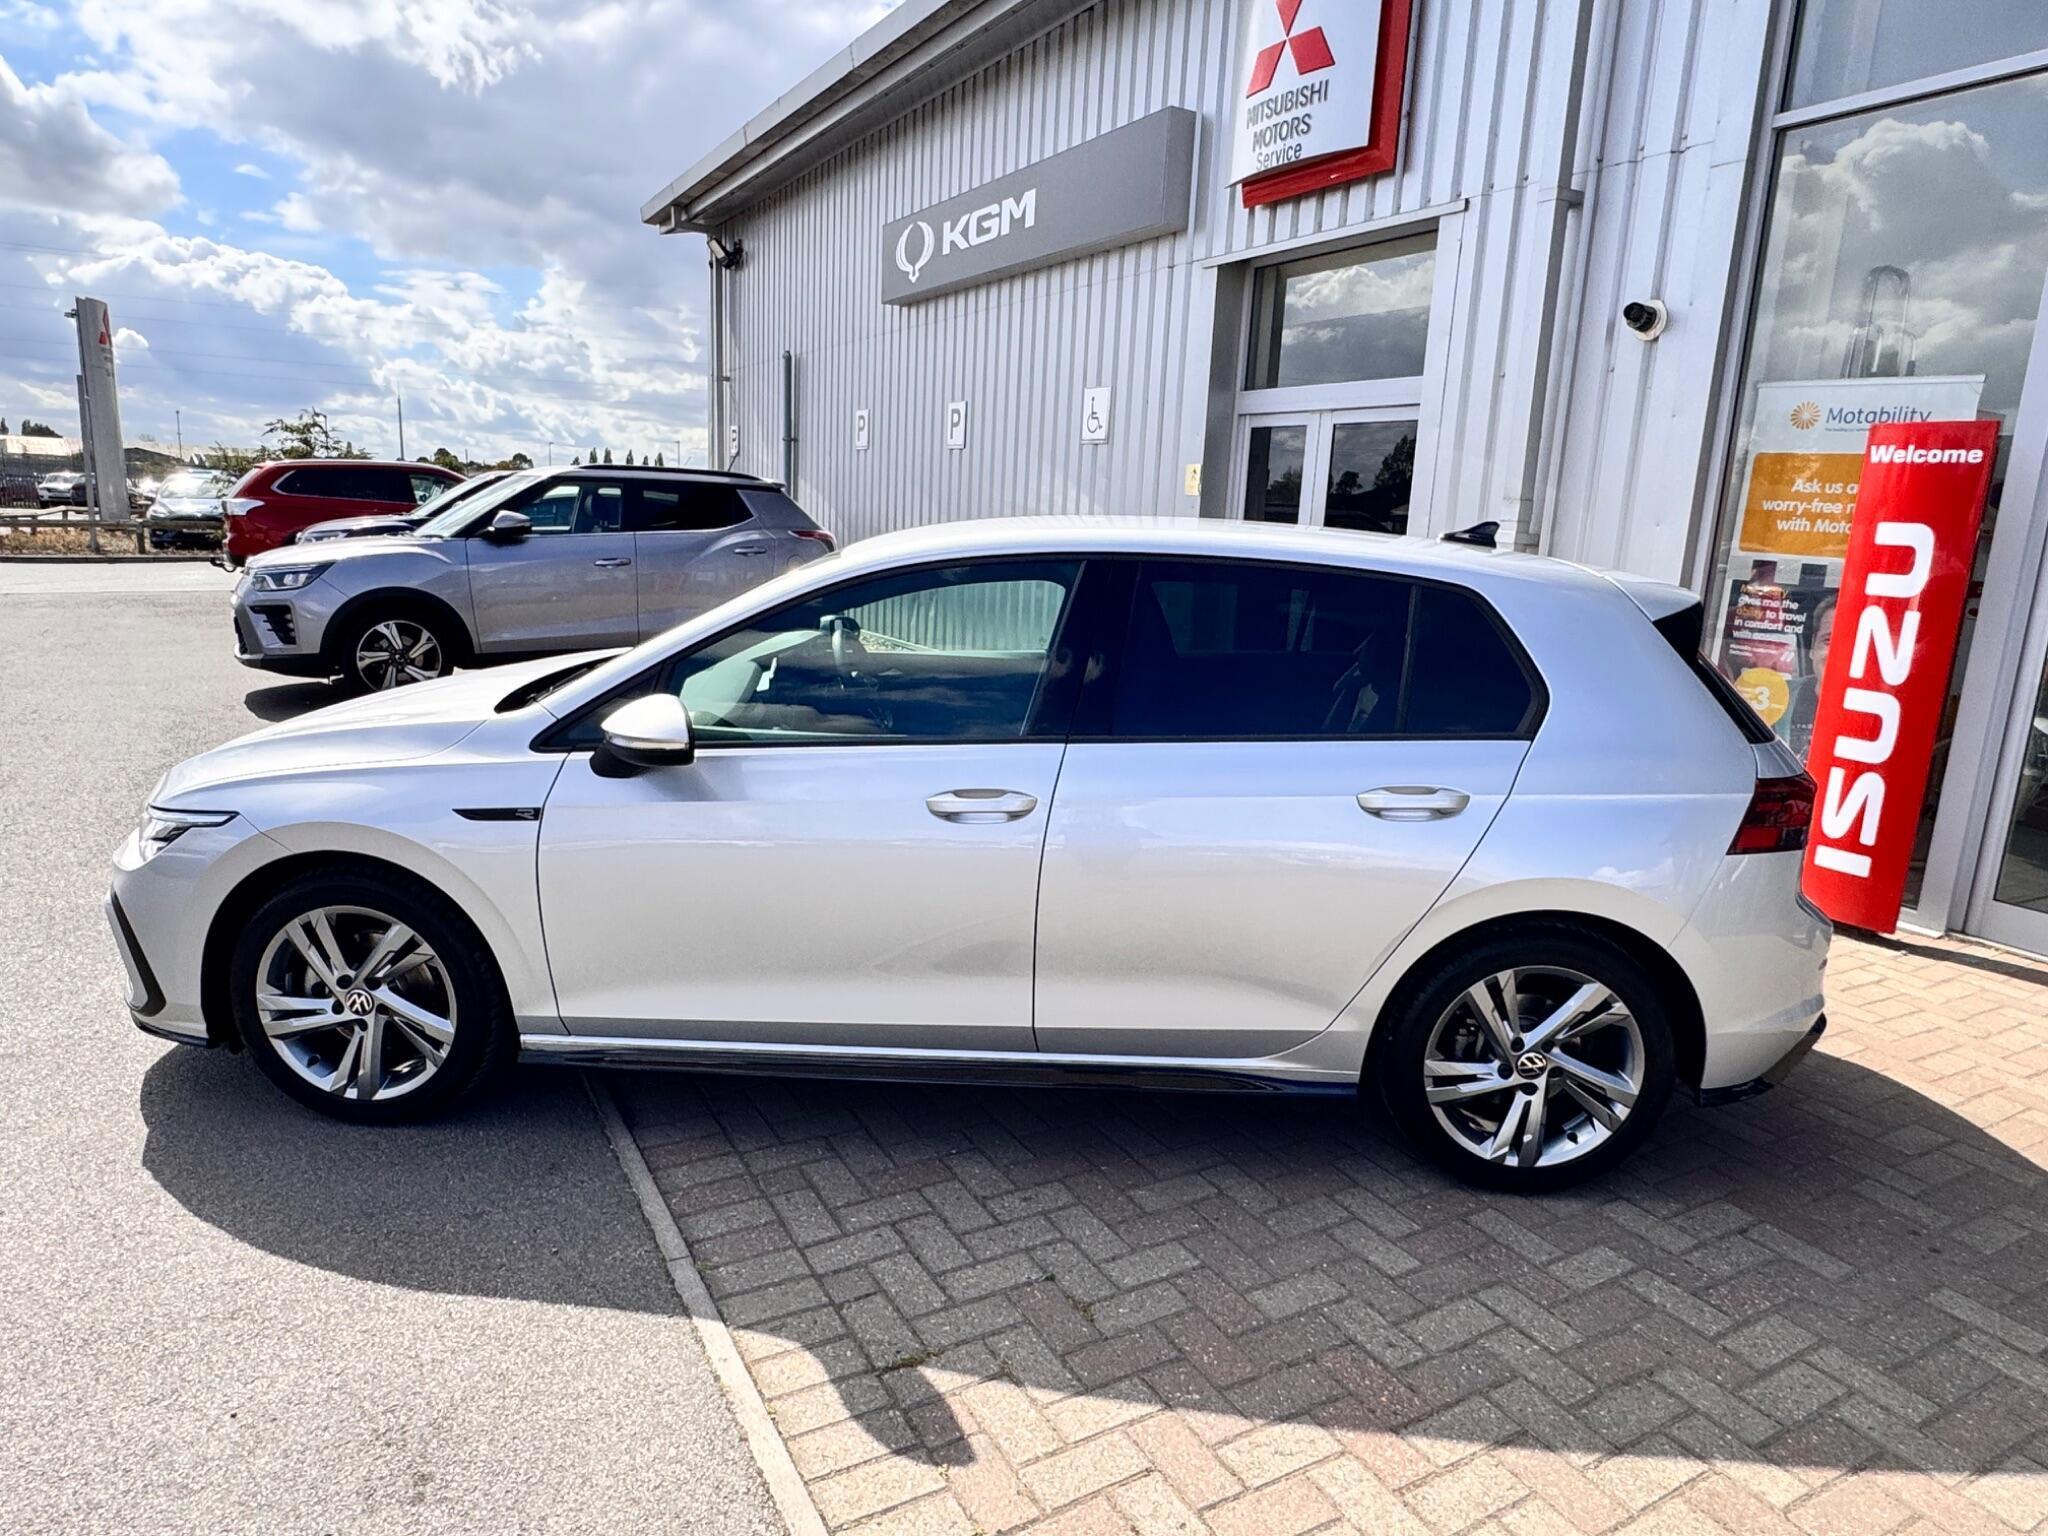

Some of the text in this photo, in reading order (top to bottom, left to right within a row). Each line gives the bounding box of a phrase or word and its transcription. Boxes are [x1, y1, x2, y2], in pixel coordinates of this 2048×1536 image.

[1246, 78, 1330, 130] MITSUBISHI
[1252, 113, 1312, 152] MOTORS
[1256, 143, 1302, 170] Service
[942, 188, 1037, 255] KGM
[858, 414, 866, 442] P
[949, 408, 961, 440] P
[1870, 444, 1983, 464] Welcome
[1791, 479, 1822, 493] Ask
[1825, 482, 1843, 494] us
[1762, 498, 1843, 515] worry-free
[1776, 517, 1811, 531] with
[1734, 616, 1743, 626] in
[1784, 624, 1804, 634] and
[1766, 610, 1776, 619] to
[1778, 610, 1807, 622] travel
[1750, 686, 1770, 710] 3
[1814, 521, 1935, 878] ISUZU
